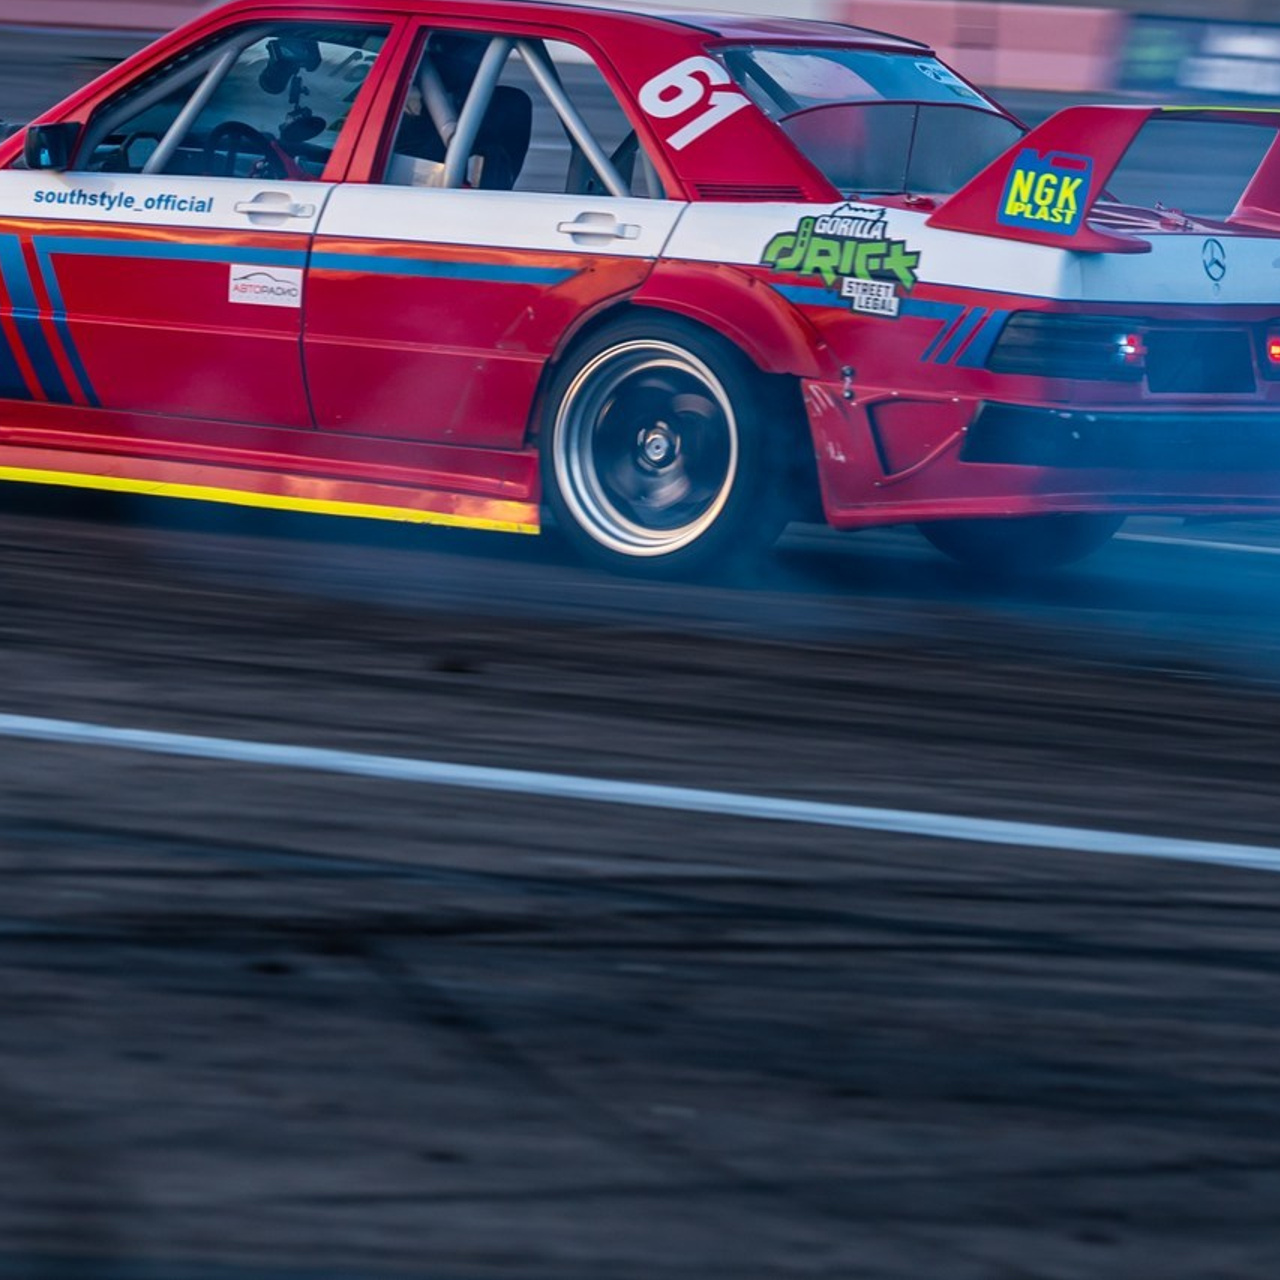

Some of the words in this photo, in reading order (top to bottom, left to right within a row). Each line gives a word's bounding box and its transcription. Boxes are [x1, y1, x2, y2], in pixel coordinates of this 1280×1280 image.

[638, 55, 752, 151] 61
[33, 189, 215, 213] southstyle_official
[1007, 169, 1083, 210] NGK
[1005, 202, 1077, 225] PLAST
[814, 215, 887, 240] GORILLA
[846, 280, 891, 297] STREET
[857, 296, 895, 313] LEGAL
